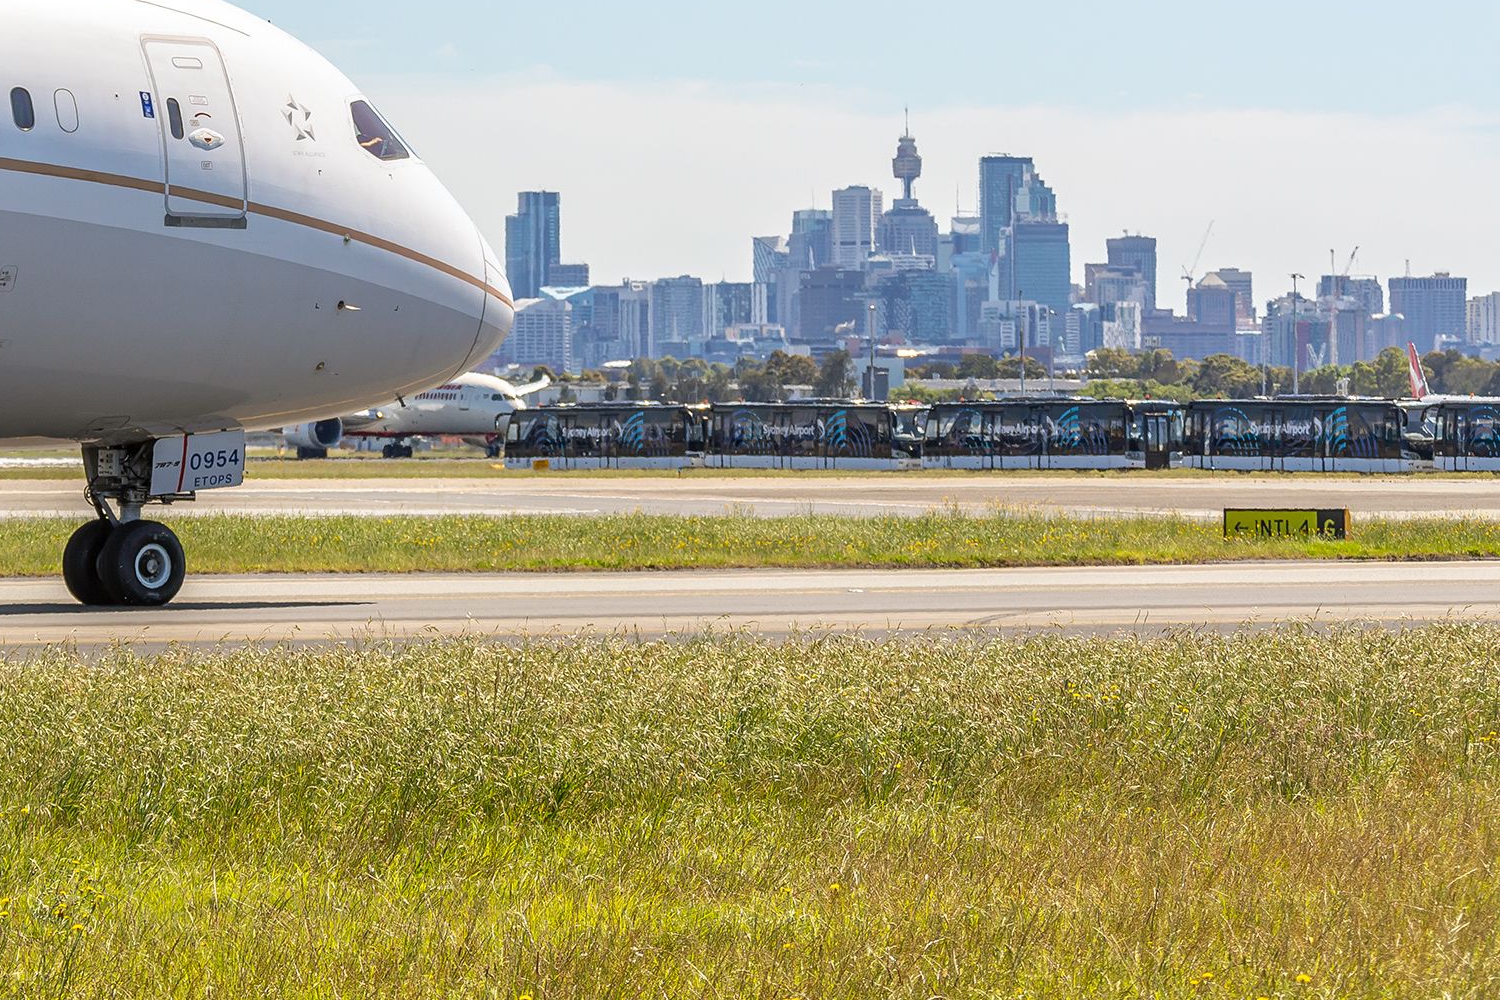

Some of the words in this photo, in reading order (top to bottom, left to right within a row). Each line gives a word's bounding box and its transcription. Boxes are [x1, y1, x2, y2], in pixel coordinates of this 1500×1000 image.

[763, 424, 788, 438] Sydney
[789, 424, 815, 439] Airport
[1250, 421, 1281, 437] Sydney
[1281, 421, 1311, 437] Airport
[190, 449, 239, 470] 0954
[194, 474, 233, 487] ETOPS
[1255, 519, 1294, 537] INTL
[1324, 518, 1336, 536] G
